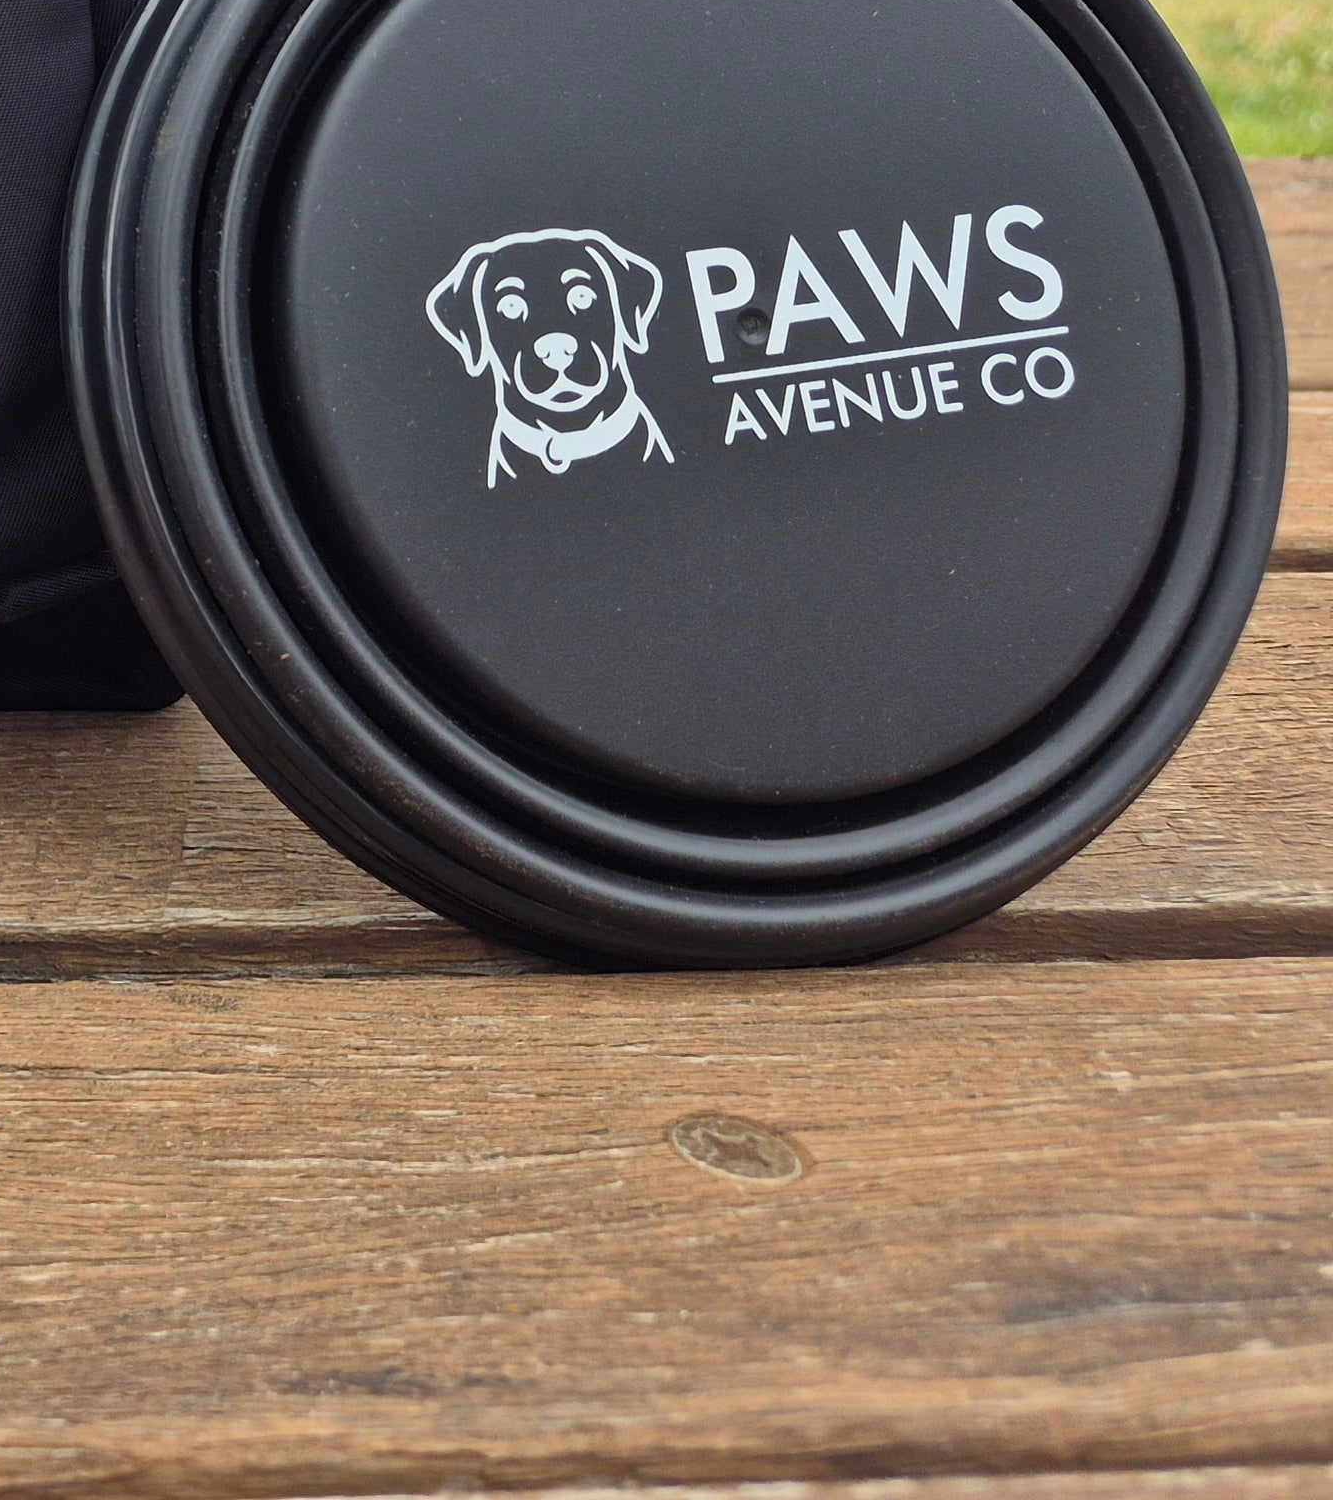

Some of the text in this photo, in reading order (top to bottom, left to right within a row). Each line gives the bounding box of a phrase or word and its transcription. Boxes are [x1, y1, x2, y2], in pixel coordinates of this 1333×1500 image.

[685, 204, 1064, 363] PAWS
[724, 347, 1076, 445] AVENUE CO
